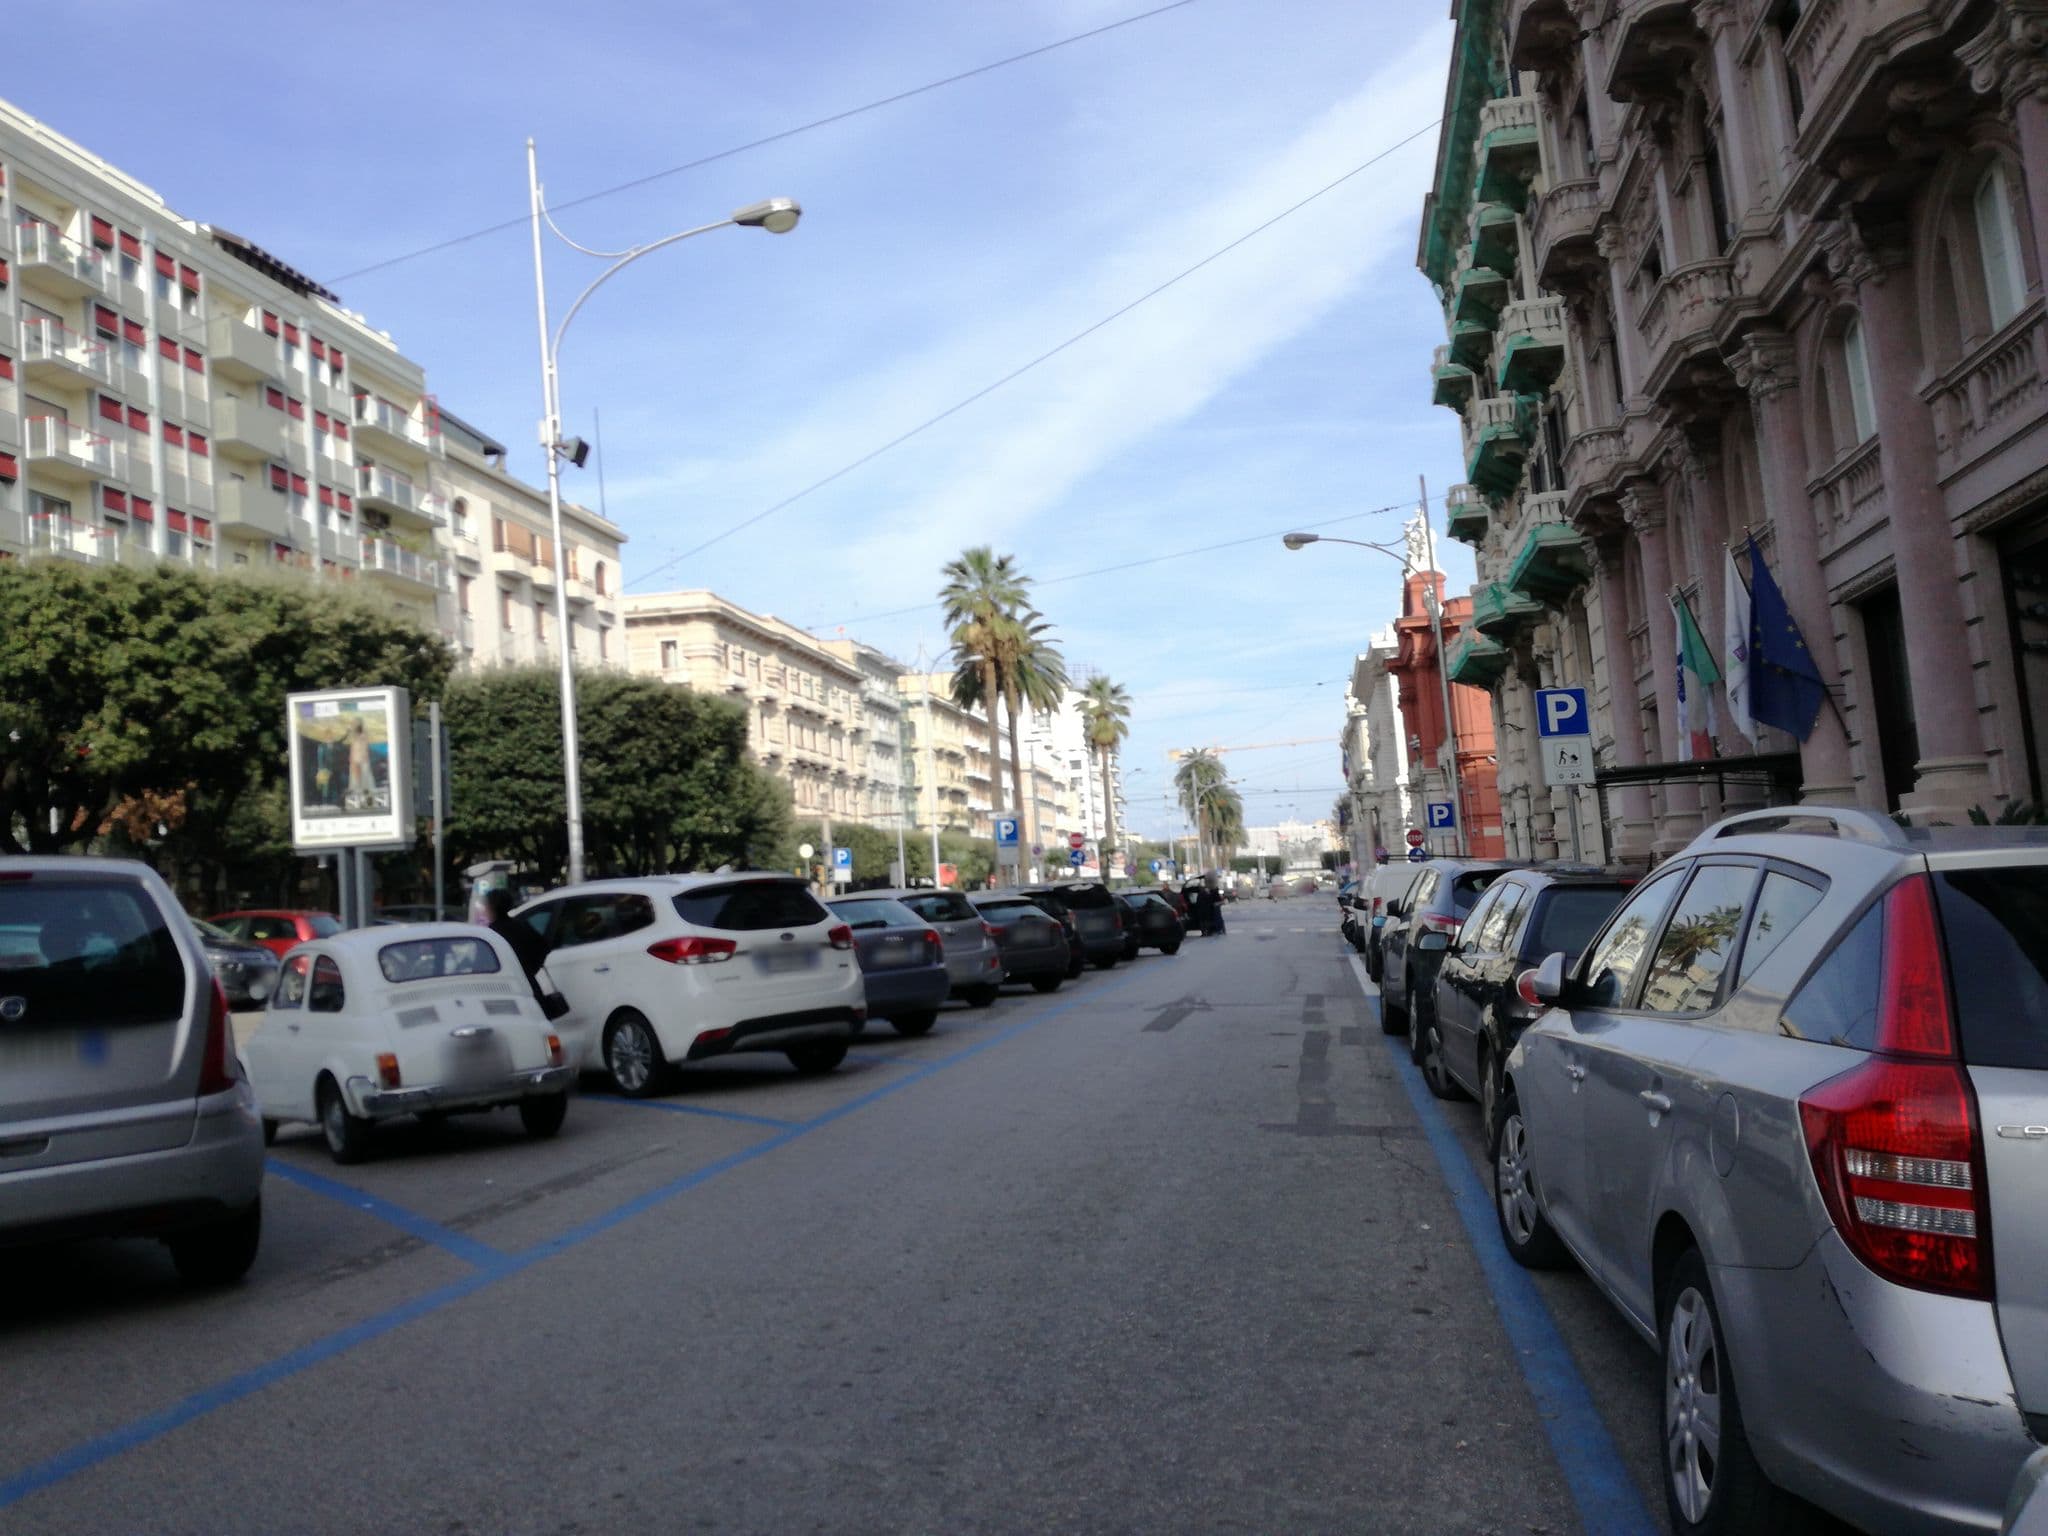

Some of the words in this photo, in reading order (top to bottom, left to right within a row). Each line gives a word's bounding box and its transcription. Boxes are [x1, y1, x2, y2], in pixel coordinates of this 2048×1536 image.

[1546, 693, 1577, 732] P
[1432, 805, 1449, 826] P
[1000, 821, 1014, 840] P
[1407, 834, 1423, 842] STOP
[837, 849, 848, 864] P
